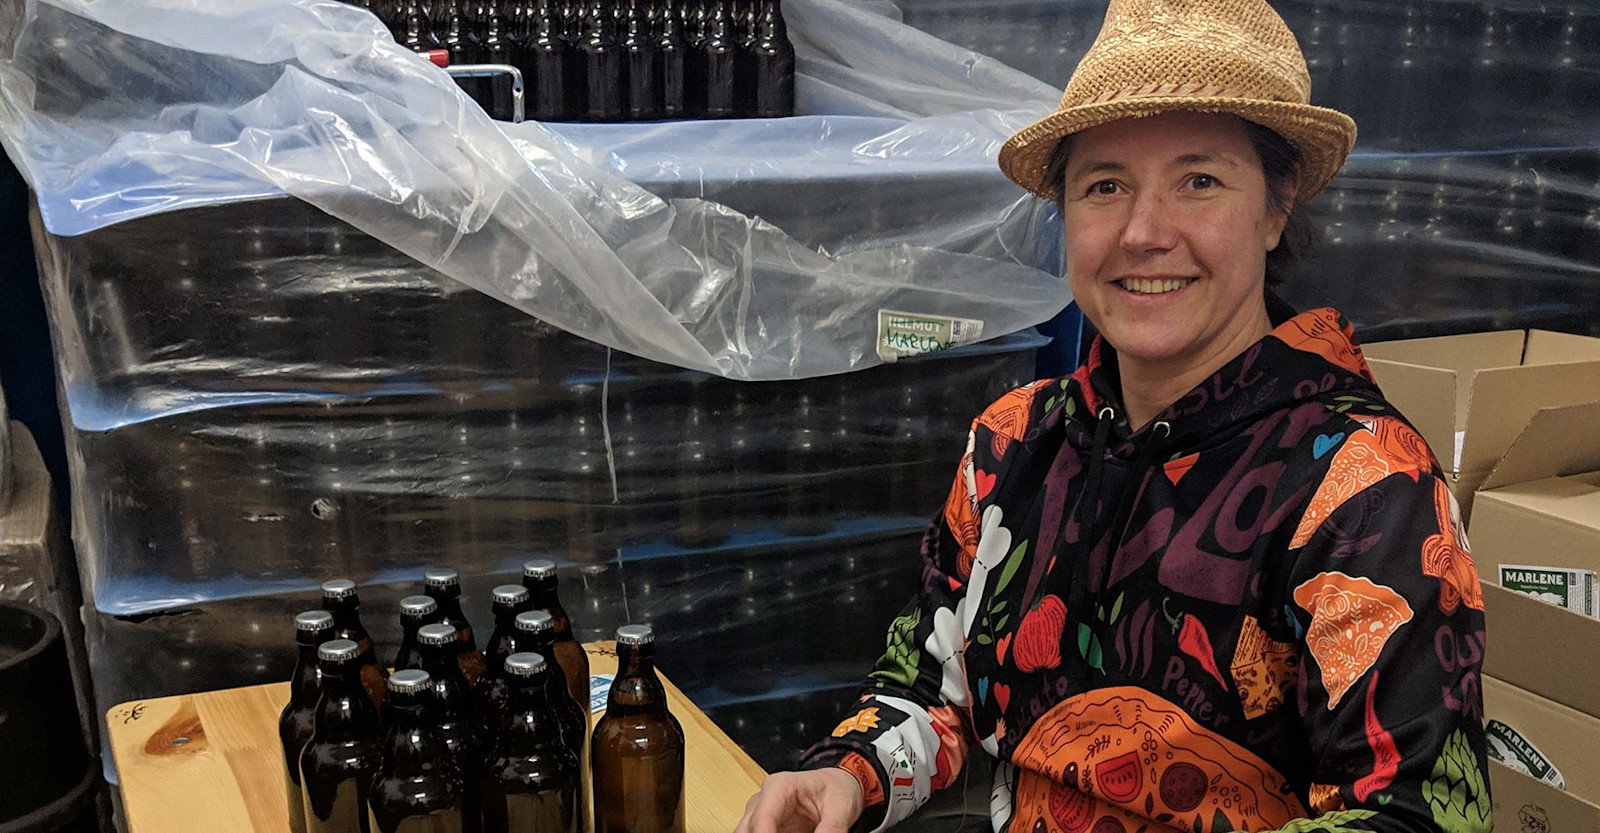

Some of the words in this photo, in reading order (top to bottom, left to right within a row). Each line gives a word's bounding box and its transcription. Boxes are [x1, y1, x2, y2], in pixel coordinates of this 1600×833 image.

[888, 316, 940, 332] HELMUT
[1505, 570, 1564, 586] MARLENE
[1161, 655, 1229, 727] Pepper
[1492, 721, 1546, 772] MARLENE
